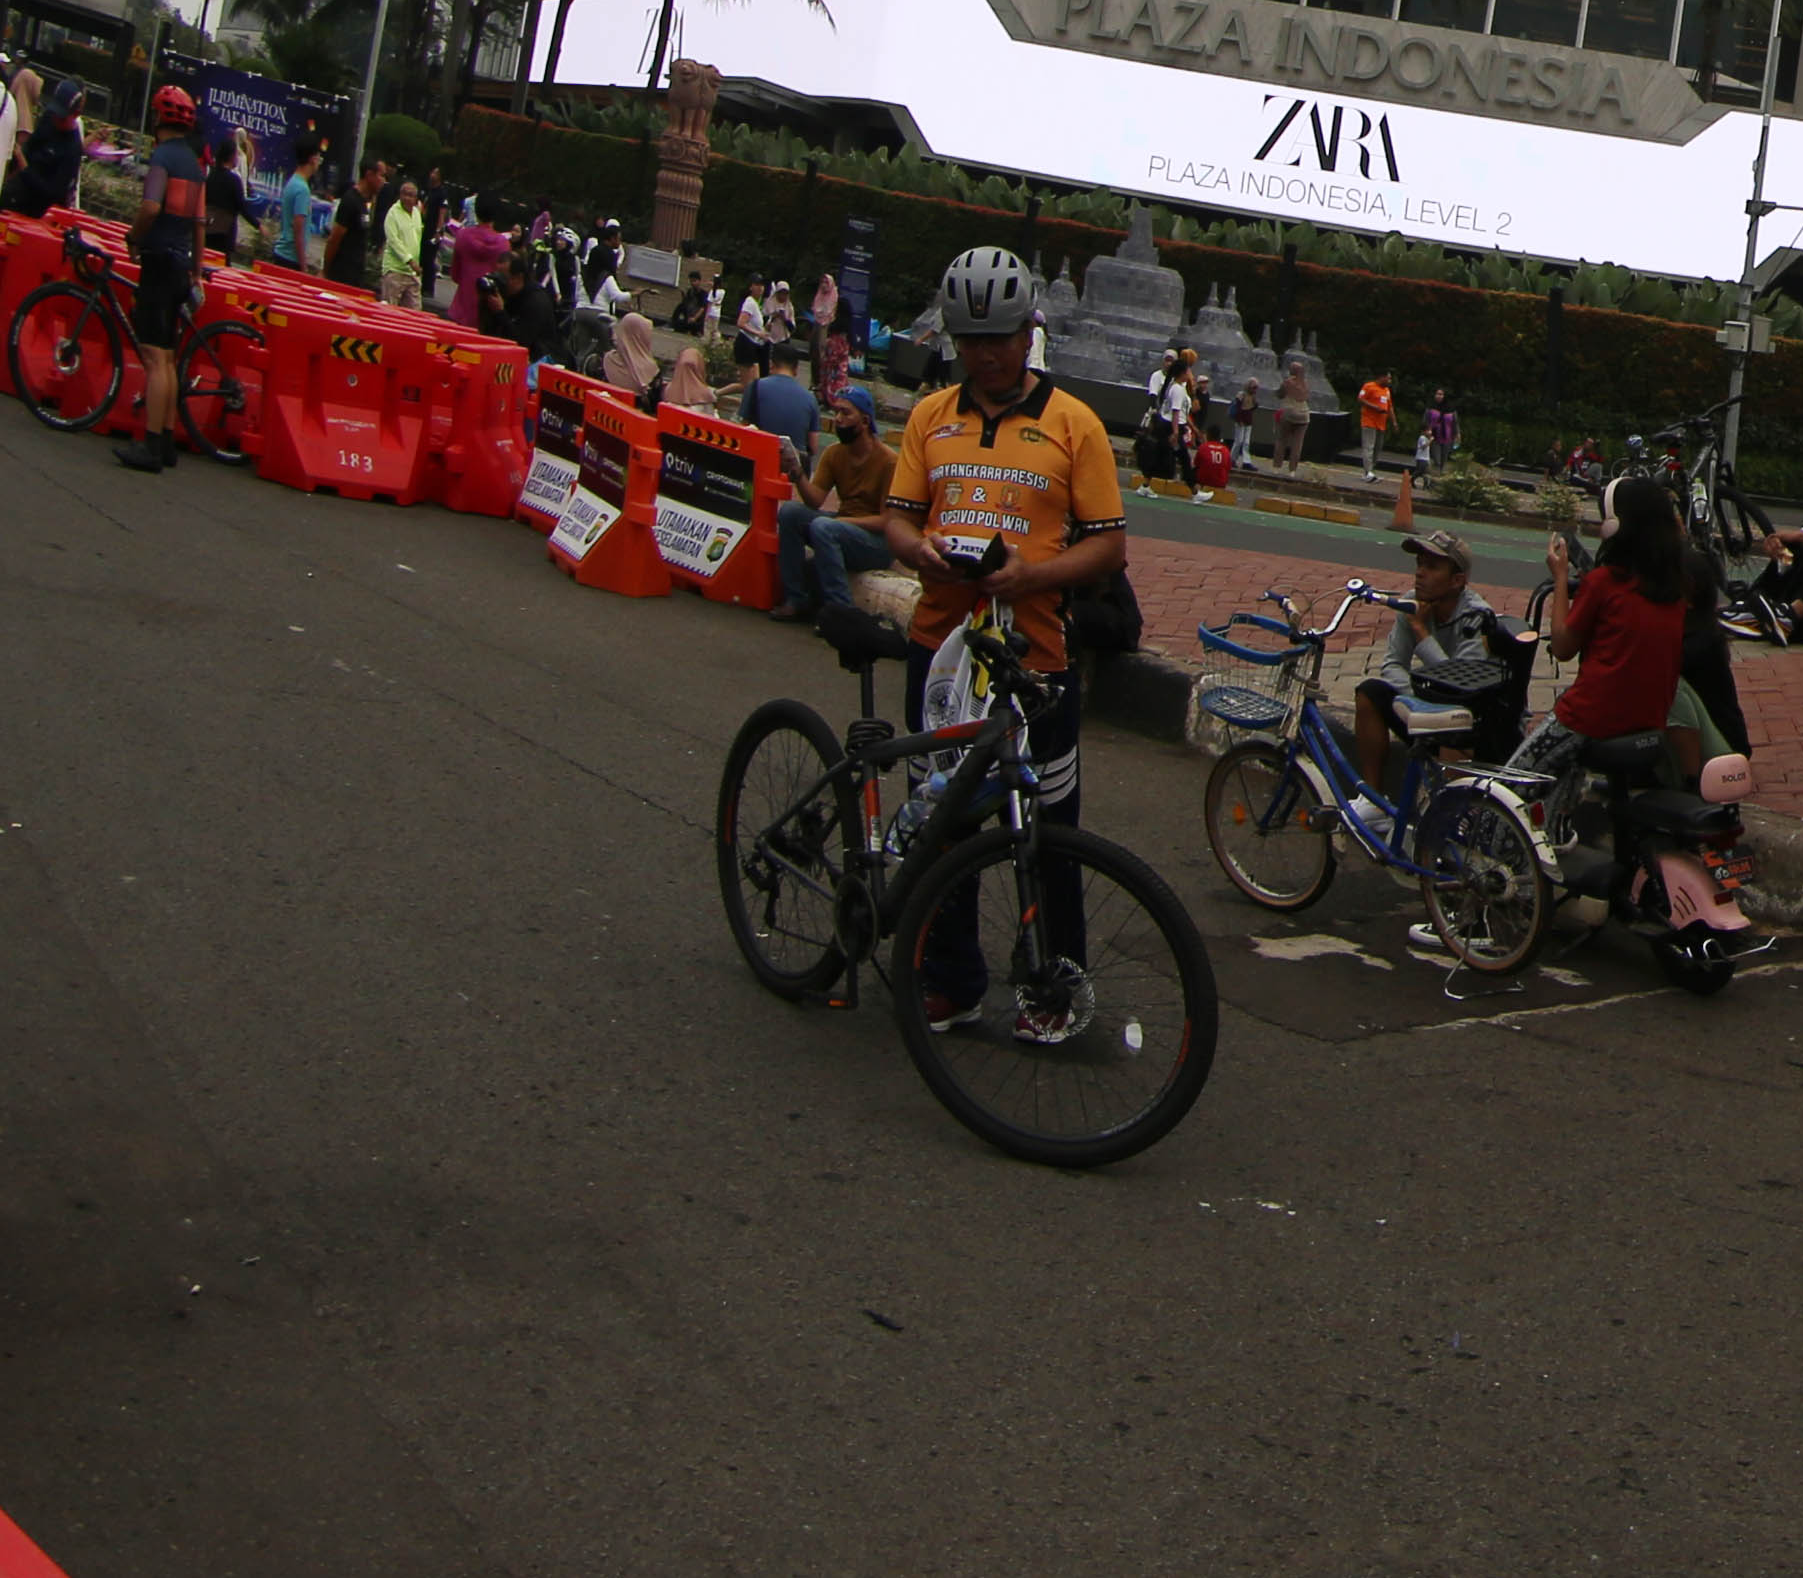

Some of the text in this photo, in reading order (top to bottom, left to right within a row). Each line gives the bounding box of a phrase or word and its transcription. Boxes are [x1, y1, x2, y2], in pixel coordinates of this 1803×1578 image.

[1276, 16, 1635, 123] INDONESIA
[220, 108, 270, 136] JAKARTA
[1252, 94, 1407, 184] ZARA
[1148, 155, 1513, 236] PLAZA INDONESIA, LEVEL 2
[338, 450, 373, 472] 183
[674, 452, 695, 475] triv
[1209, 450, 1223, 465] 10
[1003, 469, 1049, 491] PRESISI
[972, 487, 987, 502] &
[657, 508, 712, 541] UTAMAKAN
